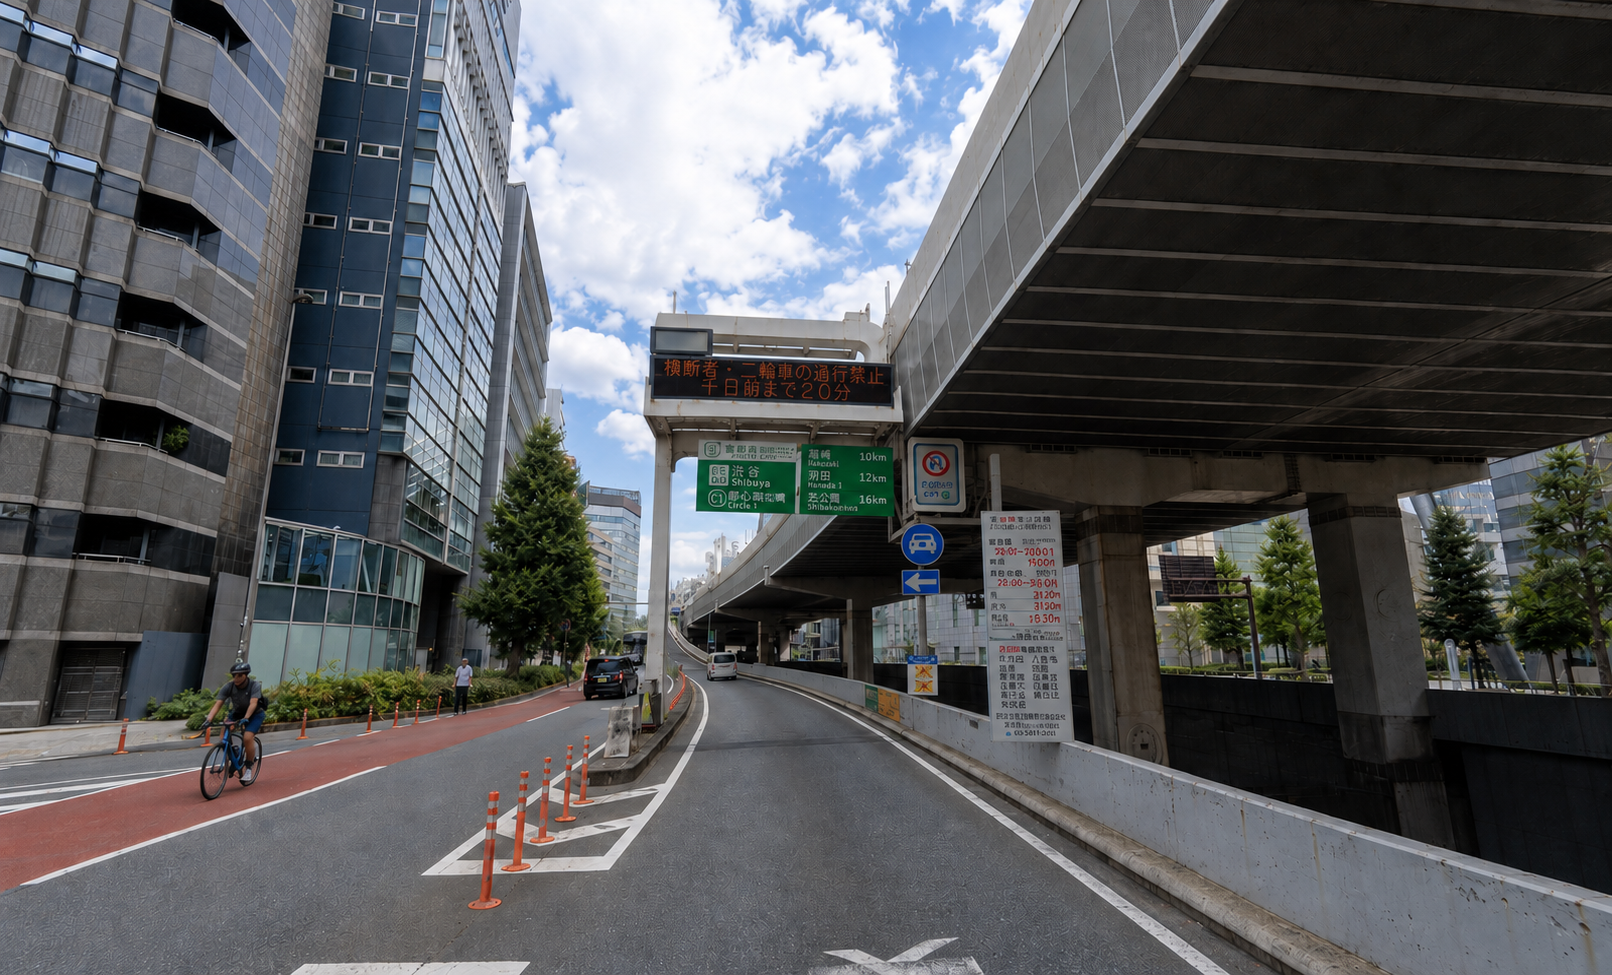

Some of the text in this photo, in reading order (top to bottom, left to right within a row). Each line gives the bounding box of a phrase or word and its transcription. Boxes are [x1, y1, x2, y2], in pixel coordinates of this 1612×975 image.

[859, 452, 887, 461] 10km
[731, 477, 771, 489] Shibuya
[859, 472, 887, 483] 12km
[710, 493, 723, 504] C1
[859, 494, 887, 505] 16km
[728, 501, 751, 509] Circle
